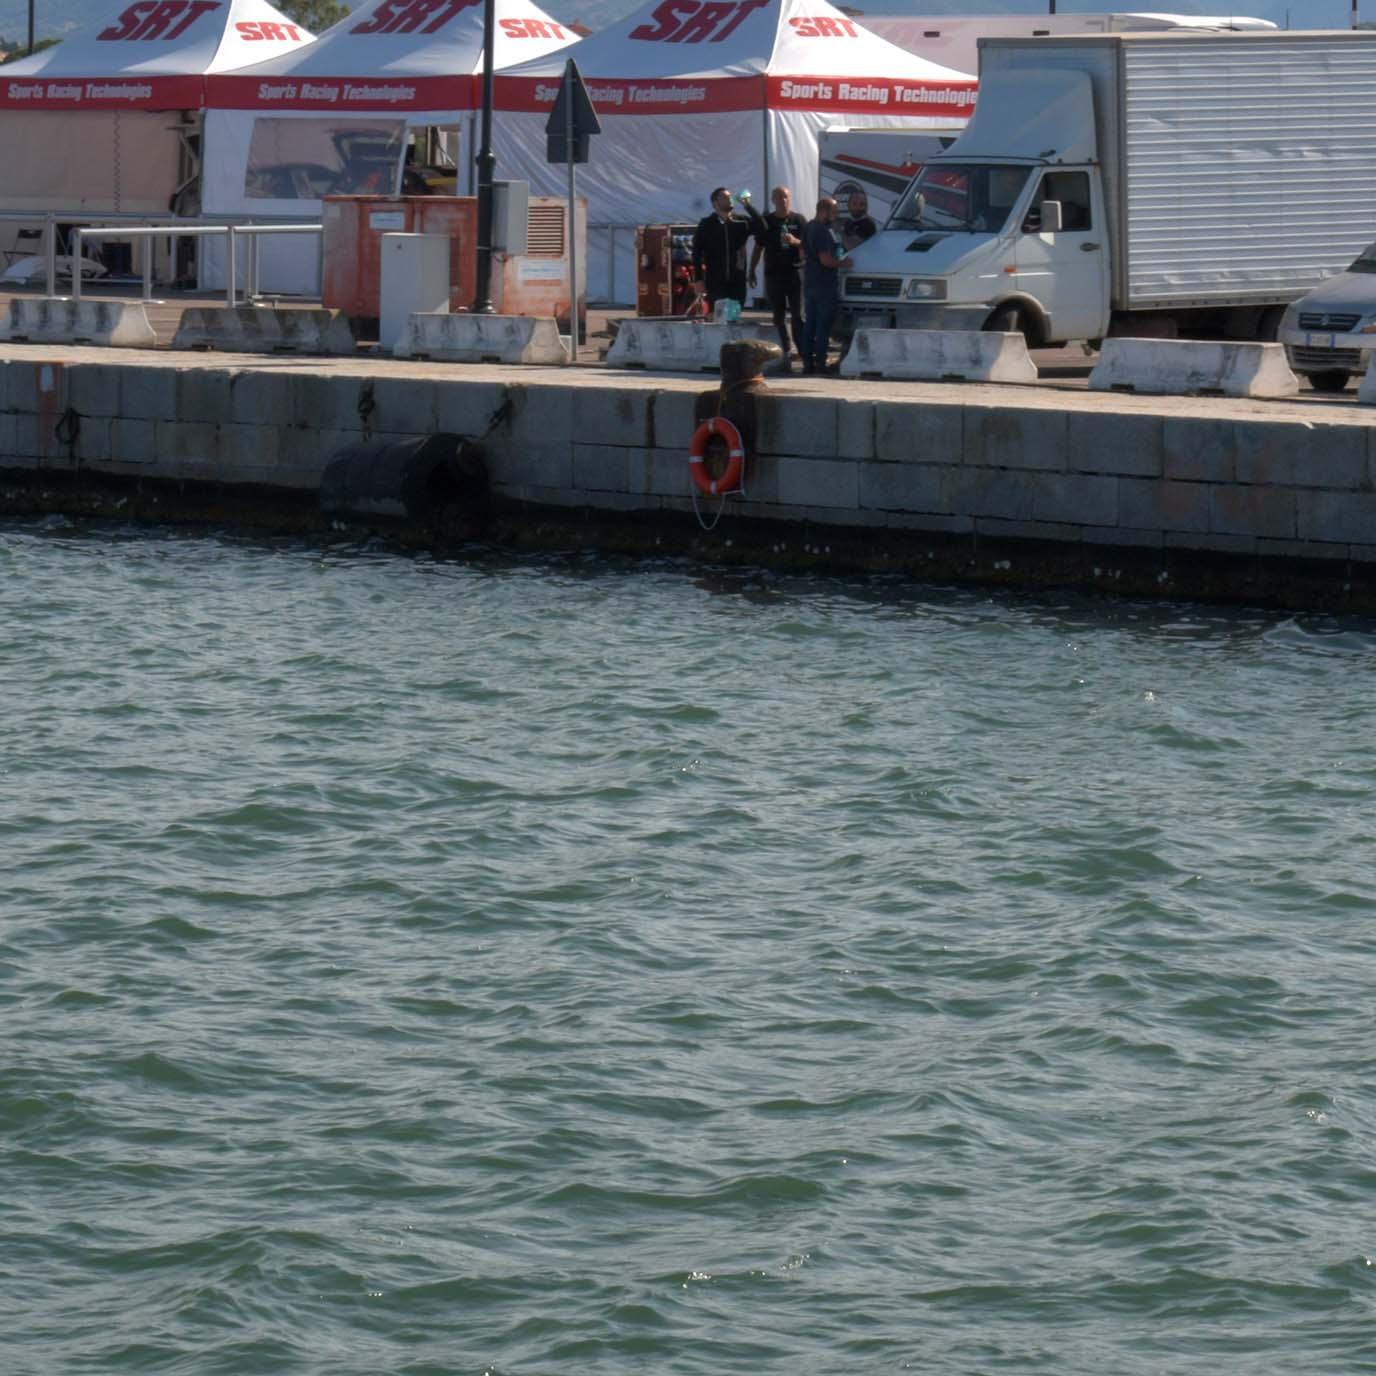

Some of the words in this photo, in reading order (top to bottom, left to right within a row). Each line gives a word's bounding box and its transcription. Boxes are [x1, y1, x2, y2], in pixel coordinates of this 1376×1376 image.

[96, 0, 223, 41] SRT
[236, 21, 303, 42] SRT
[498, 17, 566, 40] SRT
[787, 16, 859, 39] SRT
[7, 83, 43, 100] Sports
[47, 83, 82, 101] Racing
[85, 83, 153, 101] Technologies
[257, 83, 297, 100] Sports
[300, 83, 339, 102] Racing
[342, 83, 417, 102] Technologies
[628, 86, 706, 103] Technologies
[780, 80, 833, 100] Sports
[838, 83, 889, 104] Racing
[893, 85, 979, 107] Technologie
